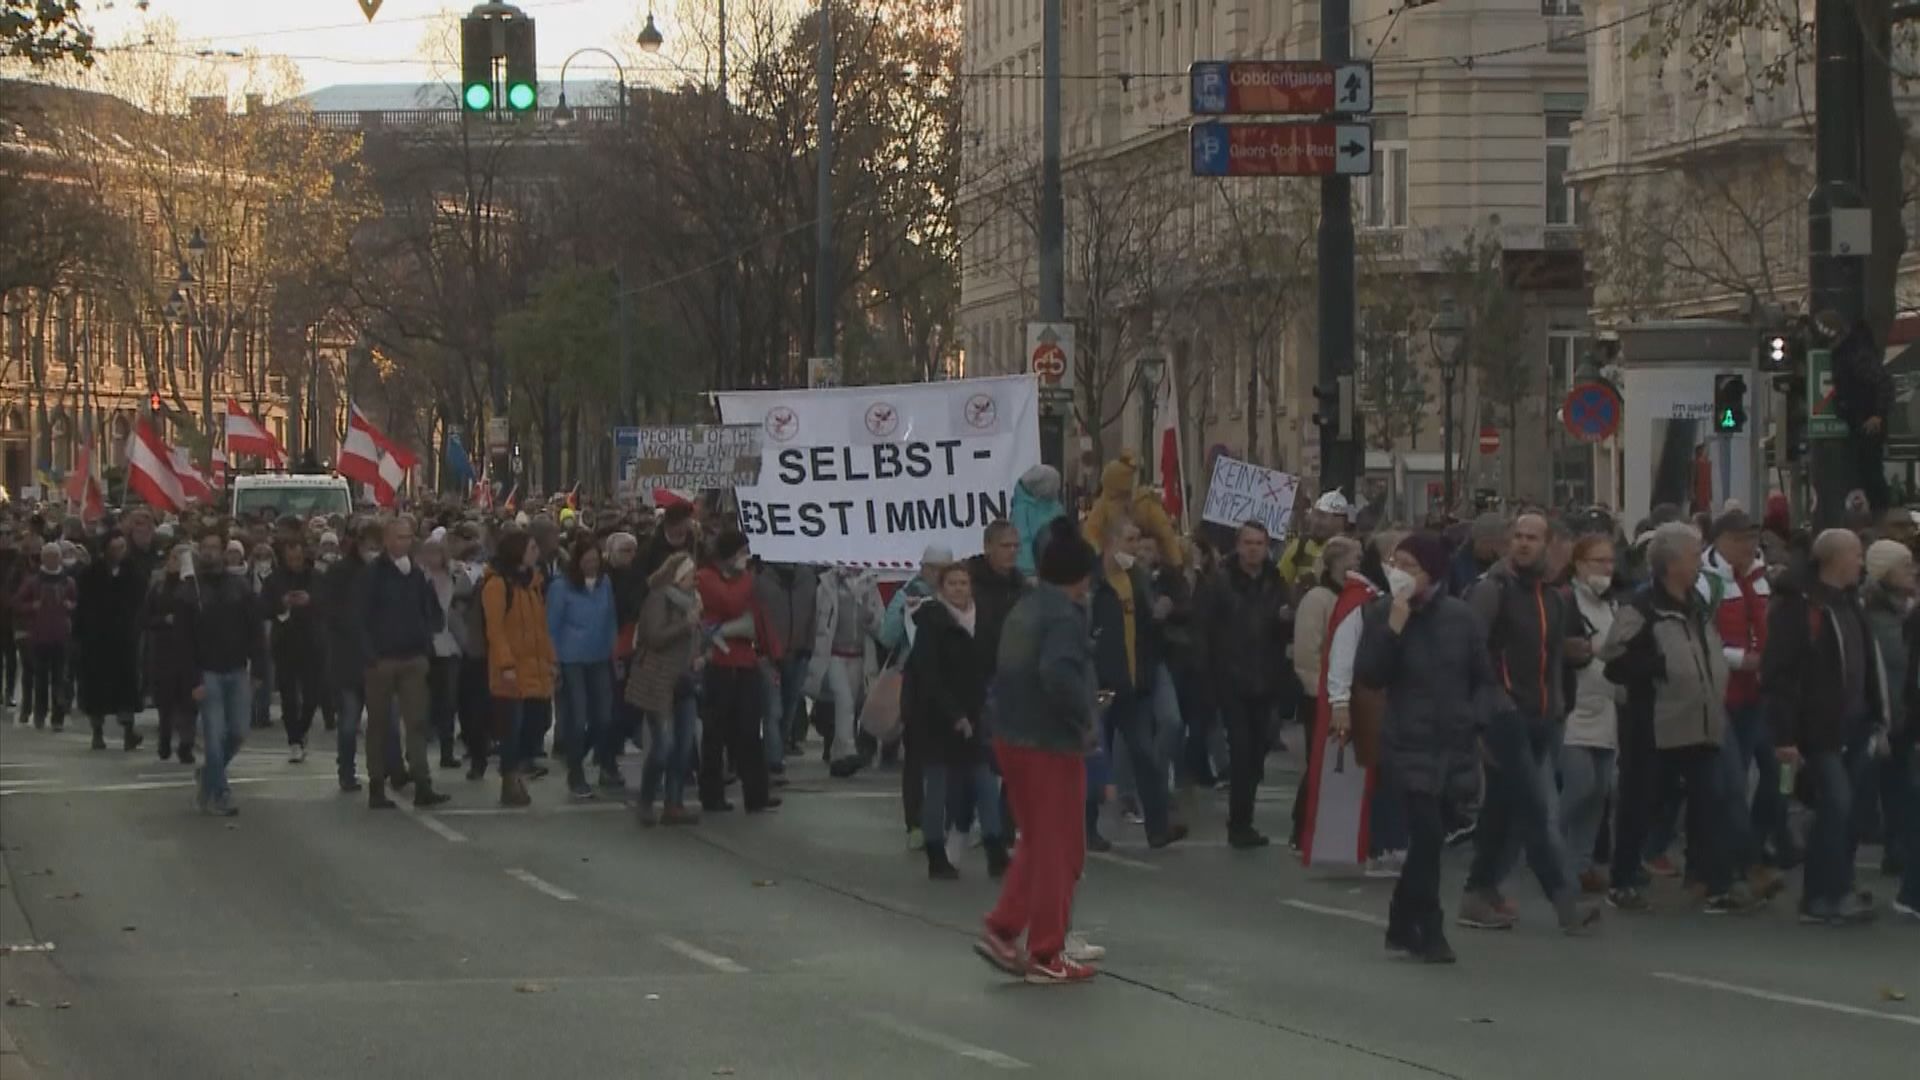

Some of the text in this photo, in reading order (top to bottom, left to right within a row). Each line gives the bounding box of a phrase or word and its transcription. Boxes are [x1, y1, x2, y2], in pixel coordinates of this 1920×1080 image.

[1230, 70, 1333, 88] Cobdengasse
[641, 429, 693, 443] PEOPLE
[708, 429, 724, 443] OF
[643, 443, 694, 457] WORLD
[1212, 457, 1257, 493] KEIN
[741, 490, 1014, 538] BESTIMMUN
